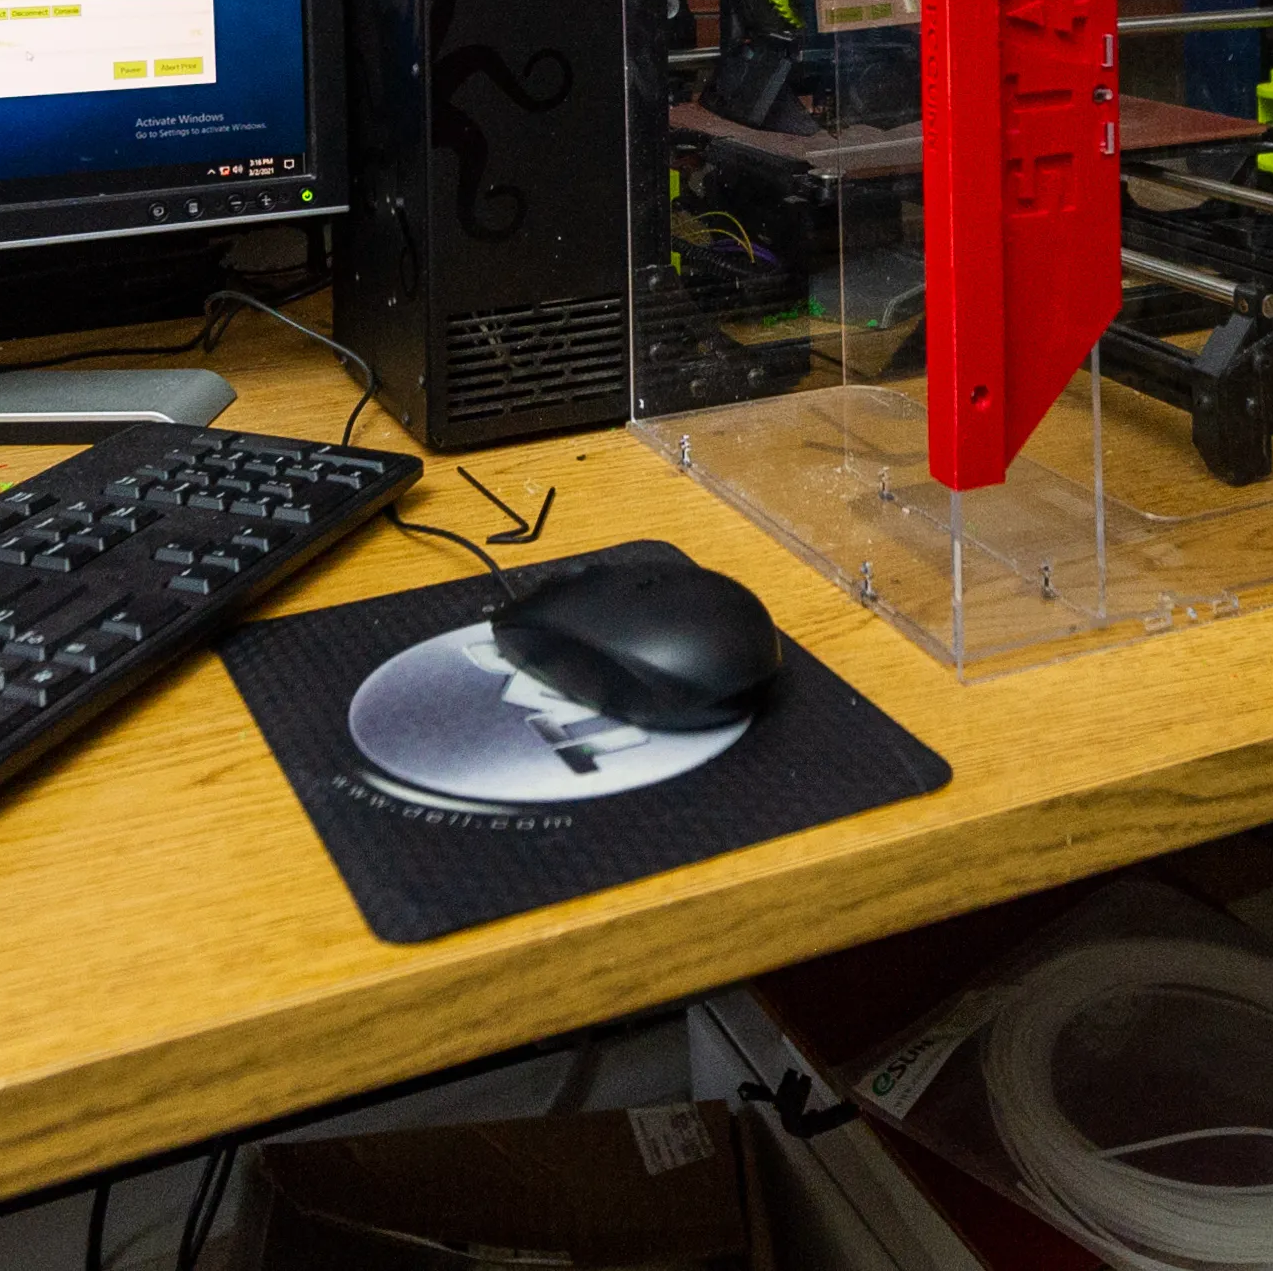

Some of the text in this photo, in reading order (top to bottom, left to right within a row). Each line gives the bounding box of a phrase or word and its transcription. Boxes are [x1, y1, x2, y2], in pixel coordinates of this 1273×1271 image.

[135, 113, 224, 127] Activate Windows
[136, 124, 229, 139] Go Settings activate
